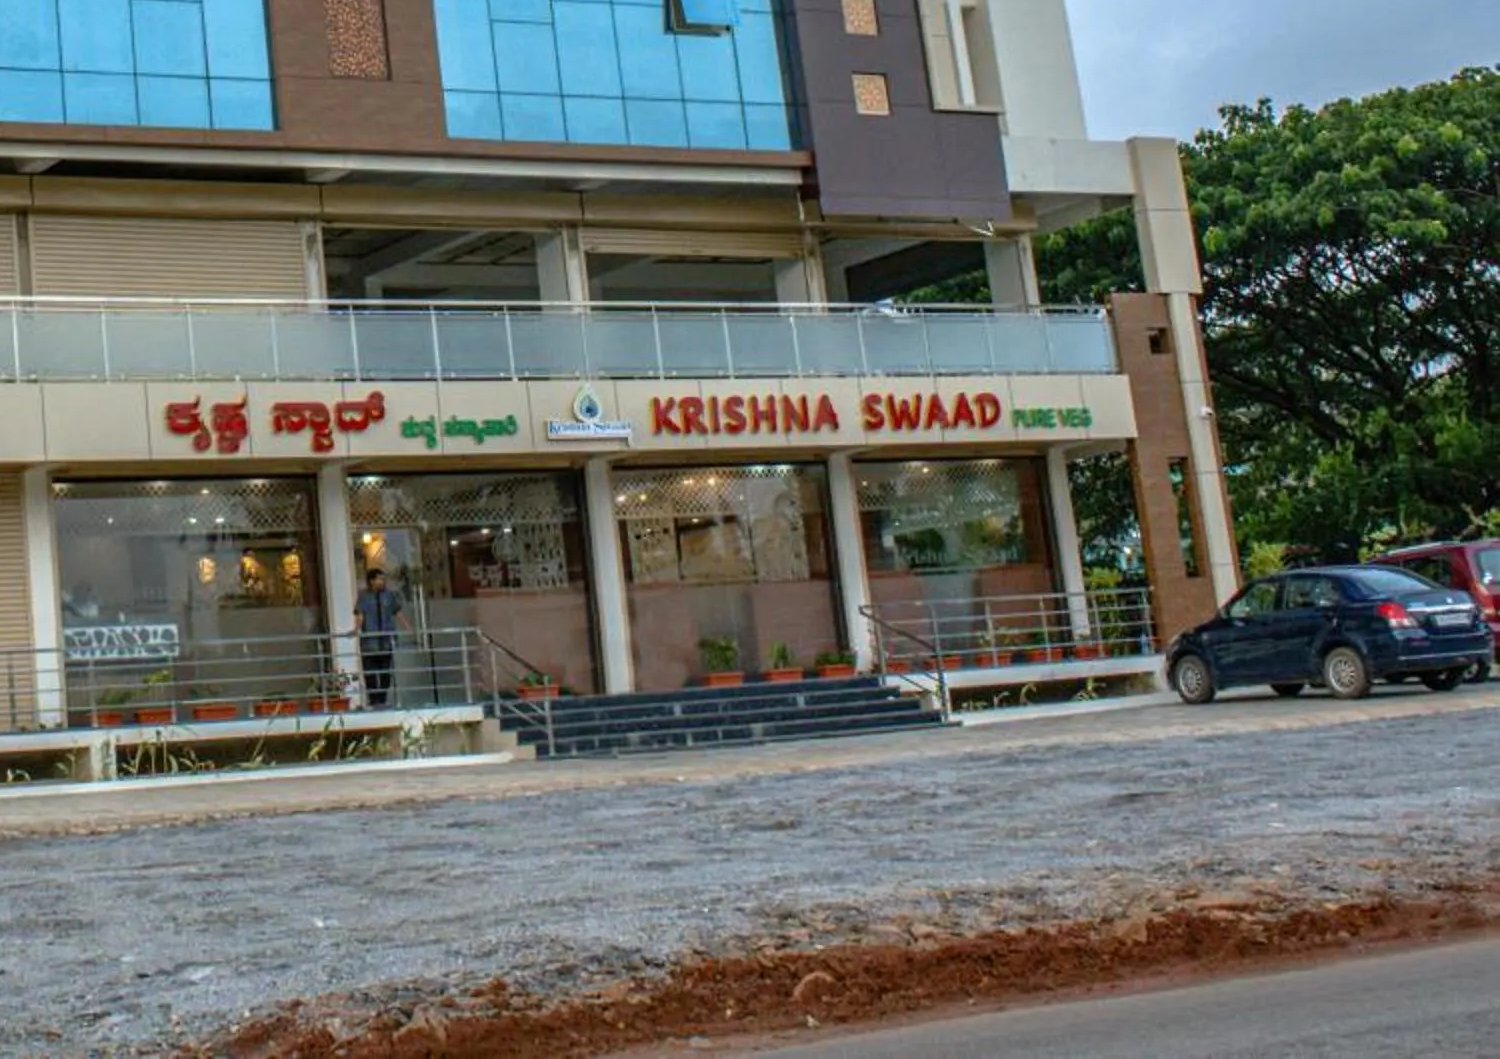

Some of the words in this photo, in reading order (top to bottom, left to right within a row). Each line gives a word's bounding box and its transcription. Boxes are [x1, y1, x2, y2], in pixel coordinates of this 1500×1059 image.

[651, 394, 839, 435] KRISHNA
[863, 392, 1002, 432] SWAAD
[1012, 407, 1057, 429] PURE
[1057, 407, 1093, 429] VEG
